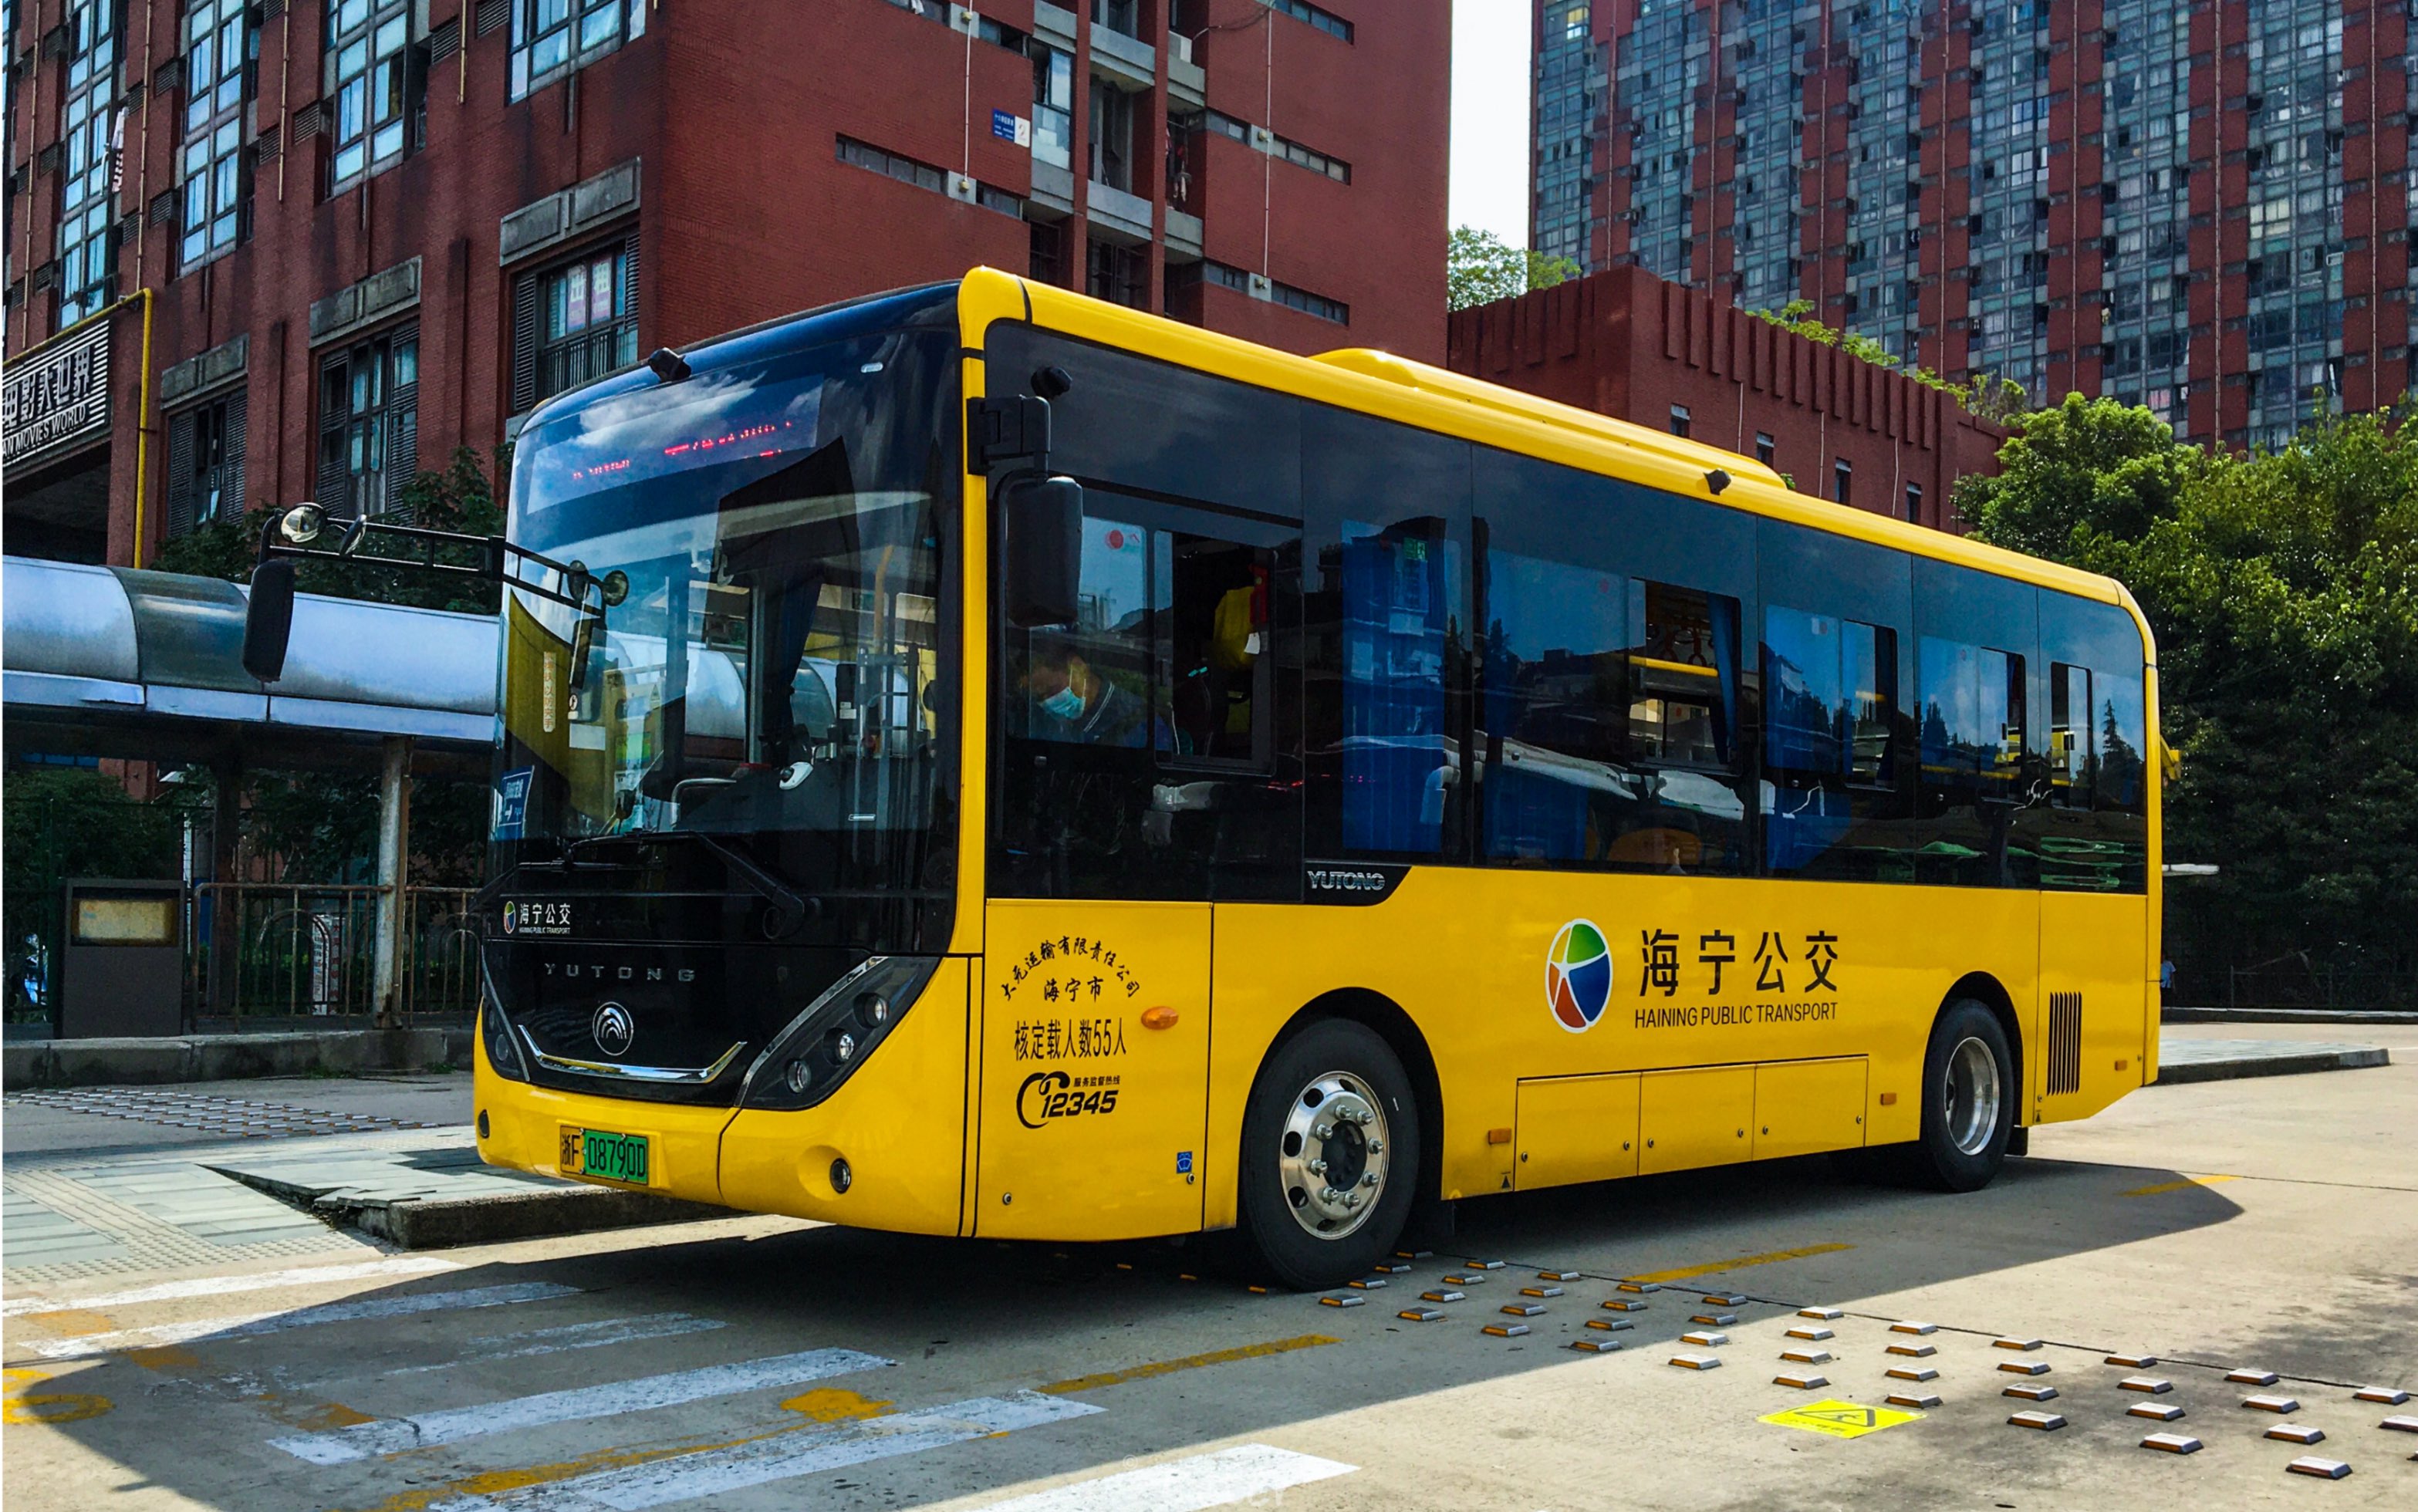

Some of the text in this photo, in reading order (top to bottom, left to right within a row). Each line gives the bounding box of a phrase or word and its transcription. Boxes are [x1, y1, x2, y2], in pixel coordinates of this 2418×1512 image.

[15, 422, 49, 453] MOVIES
[52, 404, 86, 435] WORLD
[1307, 871, 1386, 891] YUTONG
[519, 903, 571, 925] 海宁公交
[545, 963, 694, 981] YUTONG
[1639, 928, 1839, 997] 海宁公交
[1043, 975, 1104, 1003] 海宁市
[1634, 1002, 1838, 1029] HAINING PUBLIC TRANSPORT
[1014, 1017, 1127, 1061] 核定载人数55人
[1073, 1075, 1120, 1088] 服务监督热线
[1041, 1089, 1118, 1119] 12345
